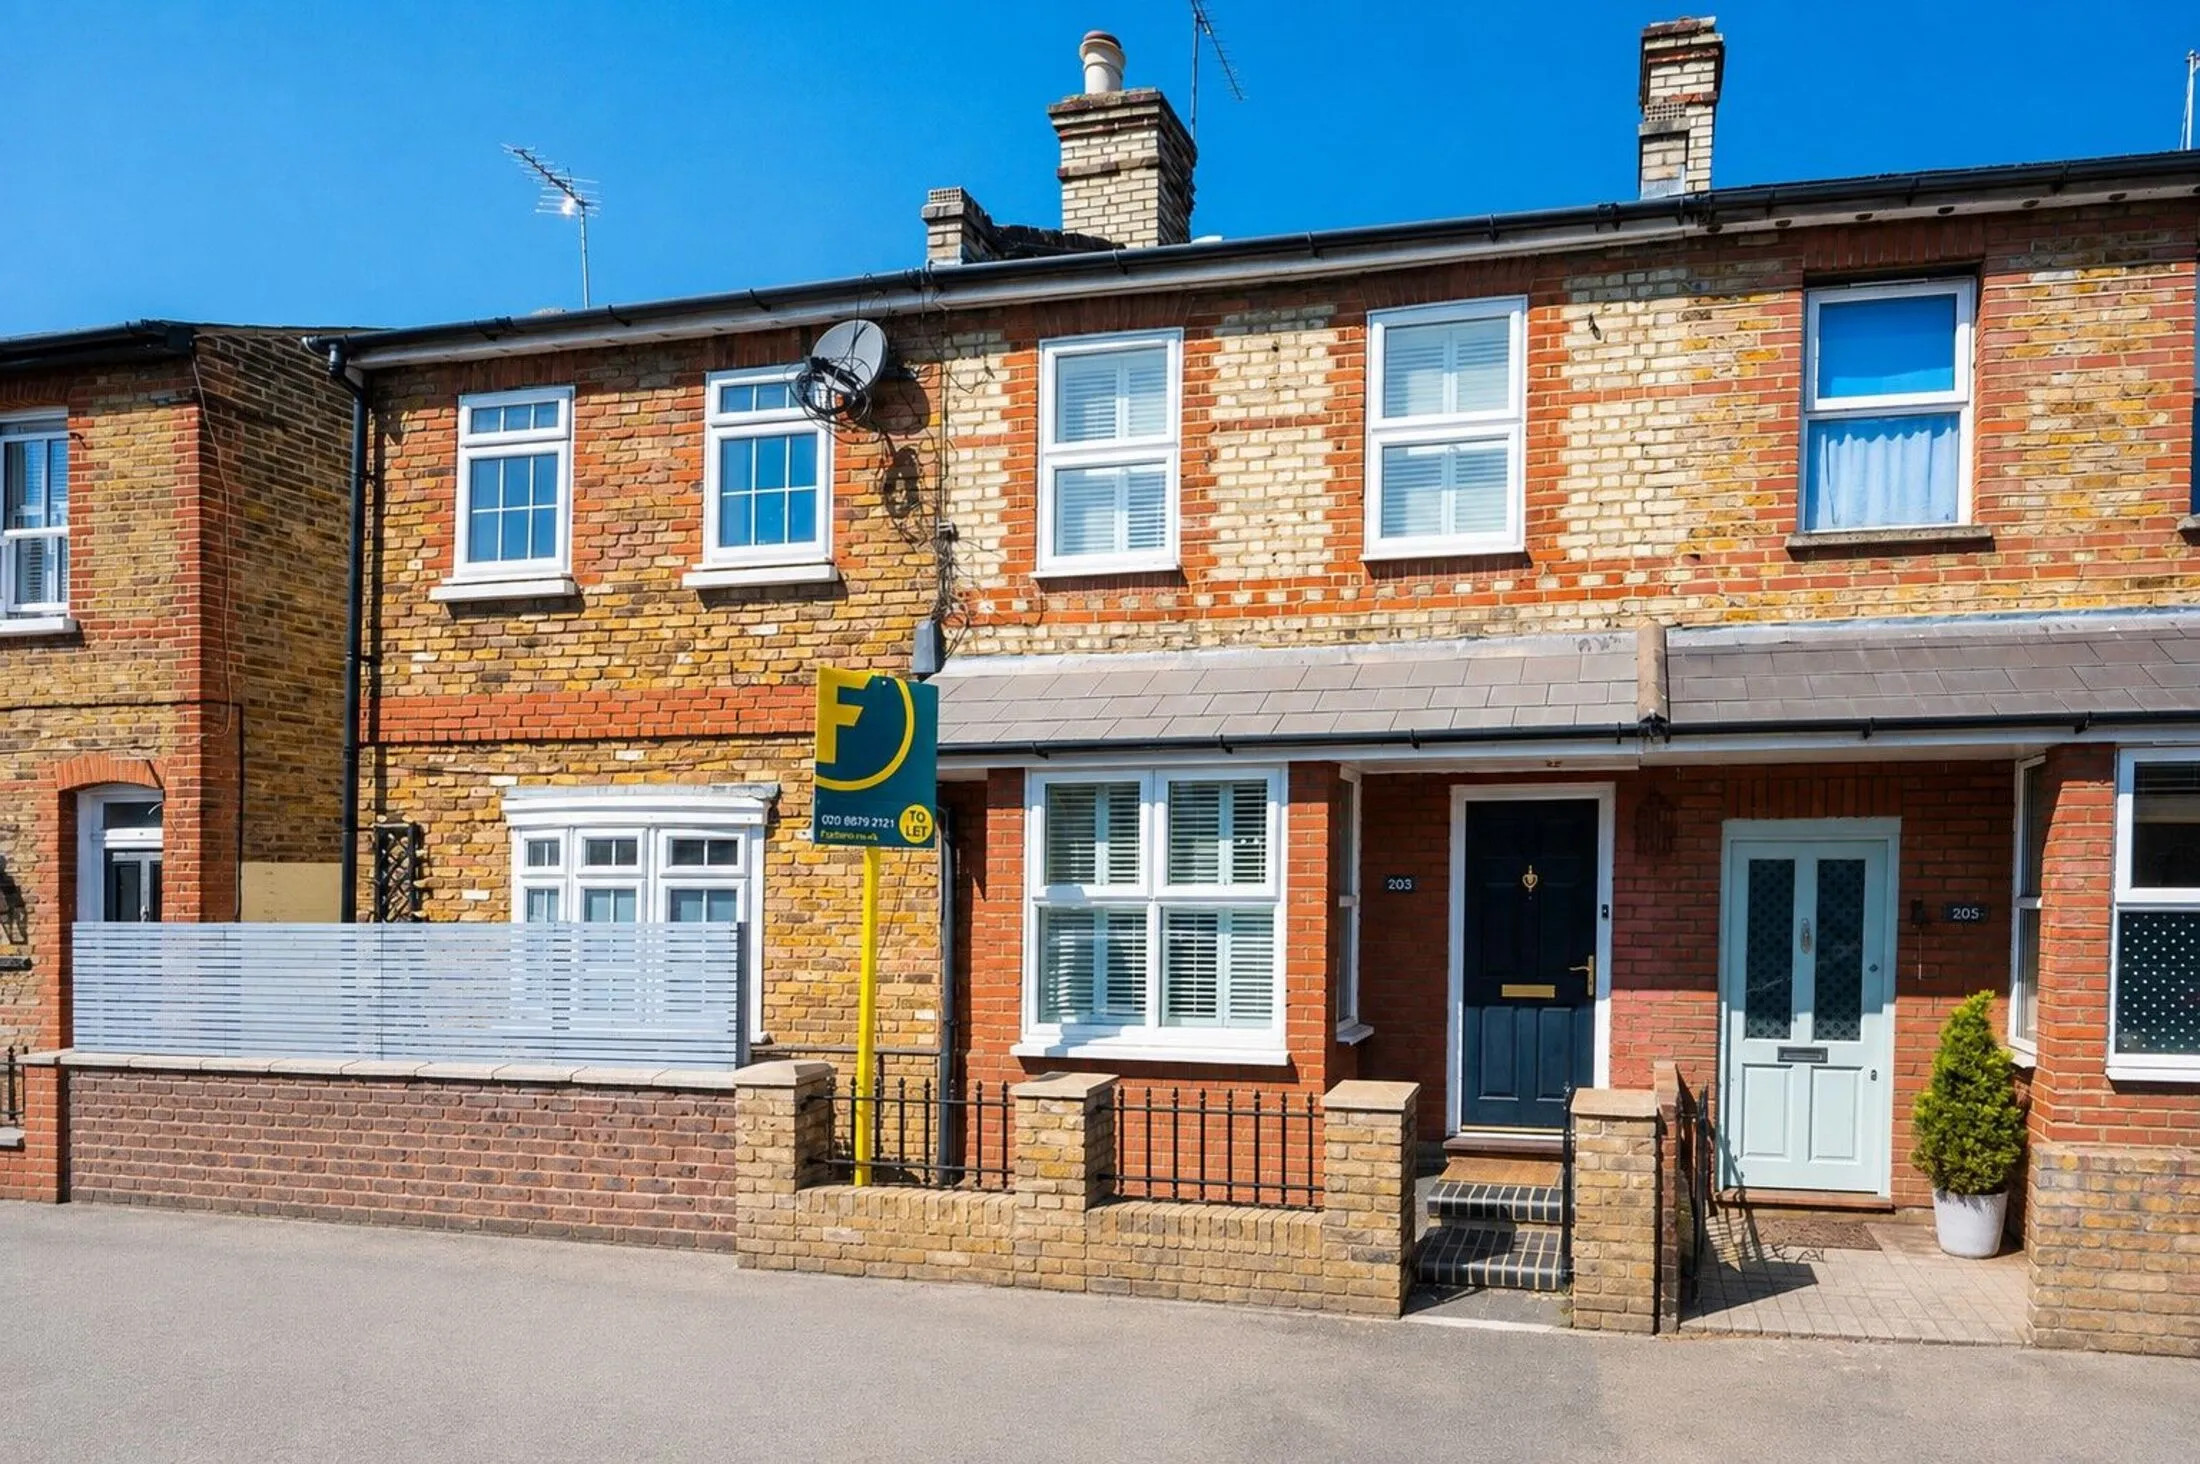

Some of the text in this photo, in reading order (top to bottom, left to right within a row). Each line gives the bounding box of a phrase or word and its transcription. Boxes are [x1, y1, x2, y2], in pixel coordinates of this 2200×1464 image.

[816, 666, 872, 764] F
[821, 814, 841, 827] 020
[908, 810, 926, 823] TO
[906, 825, 928, 838] LET
[1388, 878, 1413, 890] 203
[1953, 907, 1980, 920] 205
